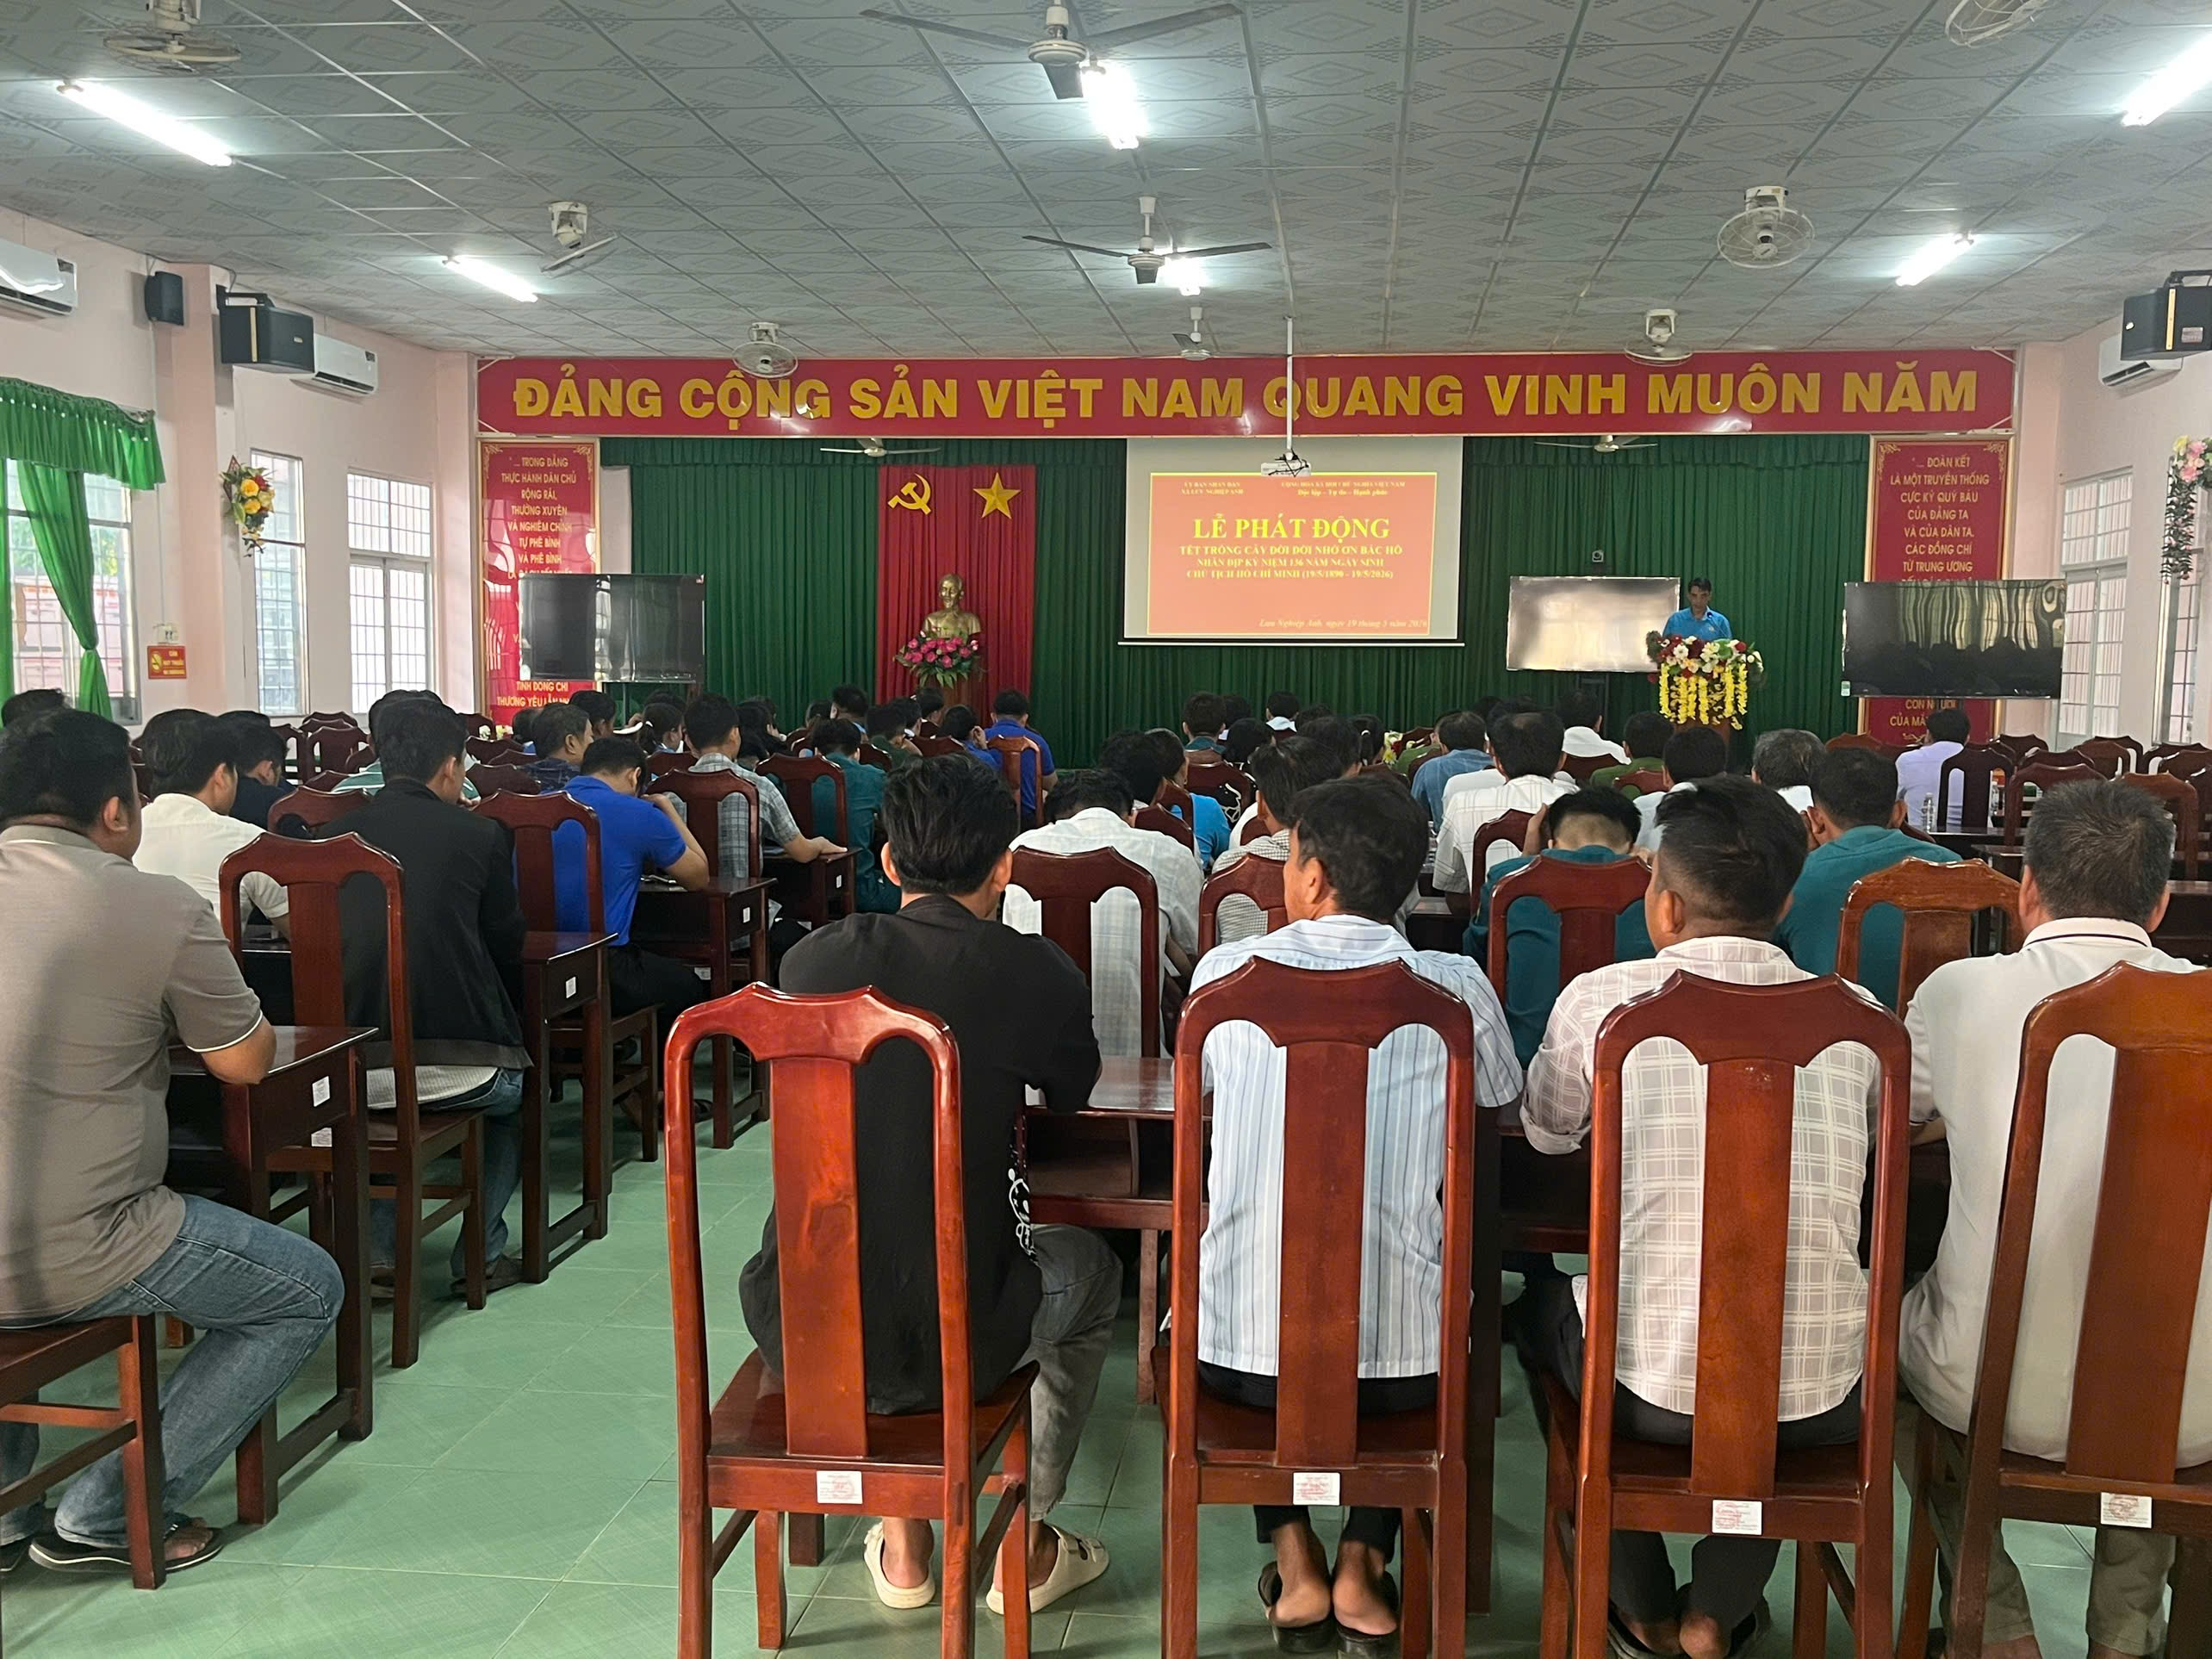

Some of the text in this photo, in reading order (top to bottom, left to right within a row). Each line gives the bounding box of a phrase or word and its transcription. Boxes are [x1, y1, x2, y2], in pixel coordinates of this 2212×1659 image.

[513, 361, 1977, 431] ĐẢNG CỘNG SẢN VIỆT NAM QUANG VINH MUÔN NĂM
[522, 457, 545, 467] TRONG
[1927, 455, 1953, 468] ĐOÀN
[1954, 454, 1971, 468] KẾT
[501, 472, 520, 484] THỰC
[522, 471, 543, 483] HÀNH
[560, 471, 577, 484] CHỦ
[1890, 471, 1990, 487] LÀ MỘT TRUYỀN THỐNG
[521, 487, 542, 500] RỘNG
[1900, 491, 1921, 504] CỰC
[1960, 489, 1979, 503] BÁU
[511, 503, 568, 516] THƯỜNG XUYÊN
[1908, 505, 1969, 520] CỦA ĐẢNG TA
[507, 519, 519, 531] VÀ
[519, 520, 549, 531] NGHIÊM
[1194, 513, 1390, 544] LỄ PHÁT ĐỘNG
[1904, 524, 1917, 537] VÀ
[1918, 523, 1939, 537] CỦA
[1941, 524, 1960, 537] DÂN
[519, 536, 562, 550] TỰ PHÊ BÌNH
[1244, 544, 1266, 556] CÂY
[1341, 545, 1358, 556] ƠN
[1360, 545, 1382, 556] BÁC
[1385, 544, 1403, 556] HỒ
[1905, 540, 1973, 556] CÁC ĐỒNG CHÍ
[519, 552, 562, 564] VÀ PHÊ BÌNH
[1903, 558, 1973, 572] TỪ TRUNG ƯƠNG
[1273, 569, 1300, 578] MINH
[497, 695, 526, 707] THƯƠNG
[527, 694, 544, 707] YÊU
[1905, 699, 1925, 710] CON
[1890, 712, 1910, 726] CỦA
